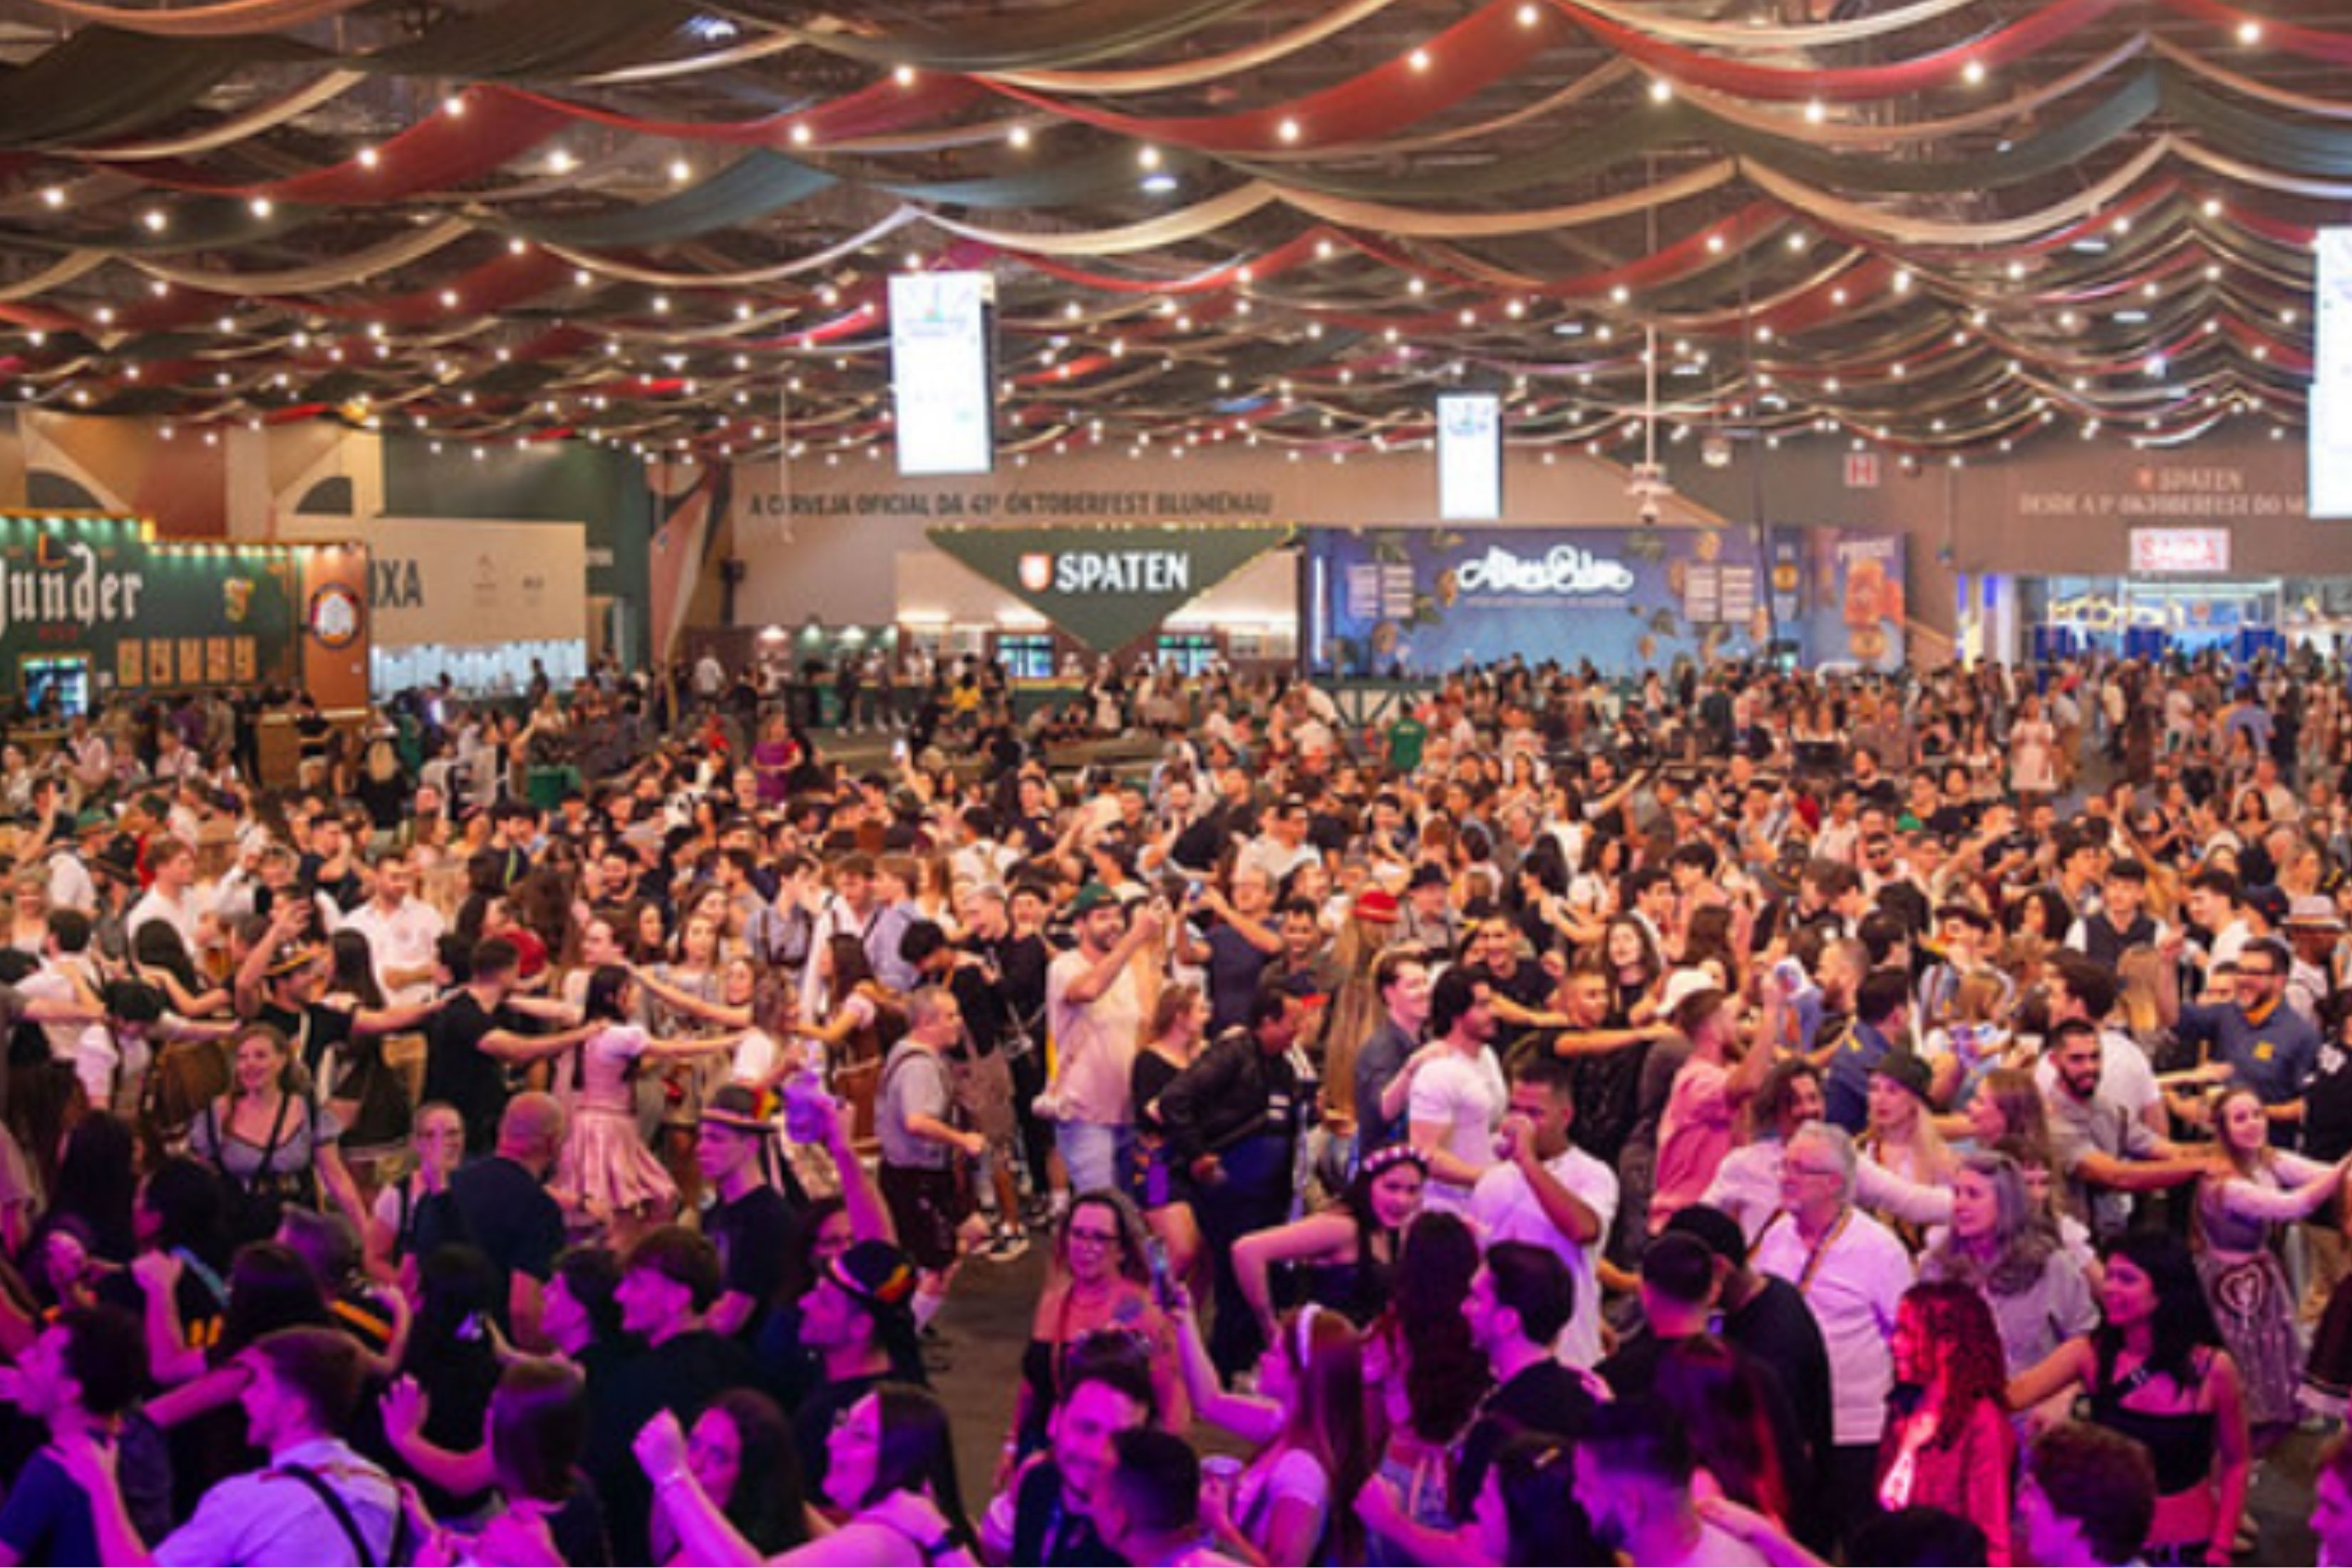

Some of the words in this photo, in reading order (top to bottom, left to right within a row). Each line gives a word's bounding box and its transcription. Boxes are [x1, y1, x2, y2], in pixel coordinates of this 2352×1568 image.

[0, 541, 143, 640] under
[368, 559, 424, 607] IXA
[1056, 551, 1189, 592] SPATEN
